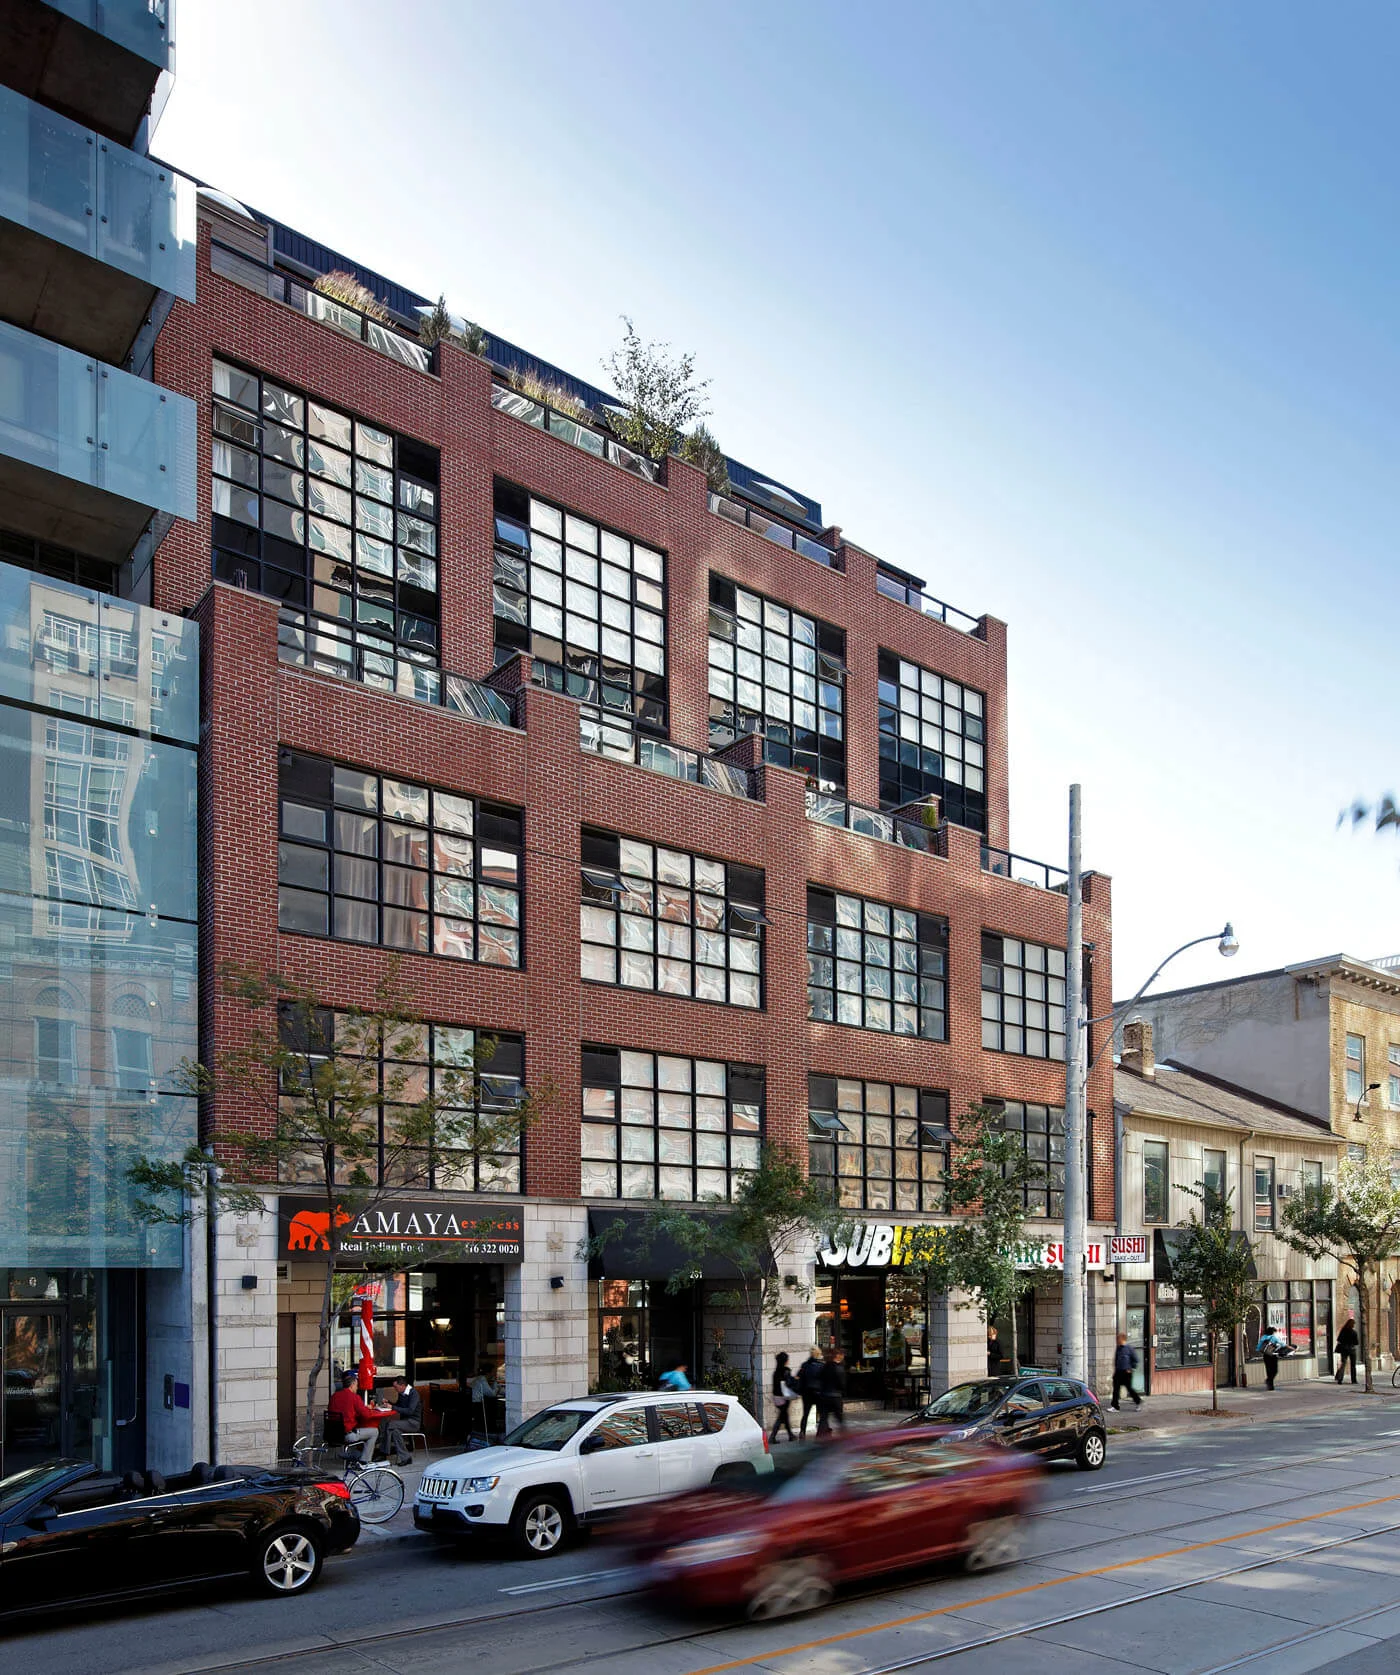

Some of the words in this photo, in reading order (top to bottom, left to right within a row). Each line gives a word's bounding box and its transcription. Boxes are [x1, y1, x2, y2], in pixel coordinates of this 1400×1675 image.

[352, 1211, 462, 1236] AMAYA
[461, 1220, 520, 1230] exress
[340, 1242, 362, 1251] Real
[400, 1242, 424, 1253] Fod
[481, 1244, 497, 1253] 322
[499, 1244, 519, 1254] 0020
[1046, 1243, 1101, 1264] SUHI
[1111, 1237, 1145, 1253] SUSHI
